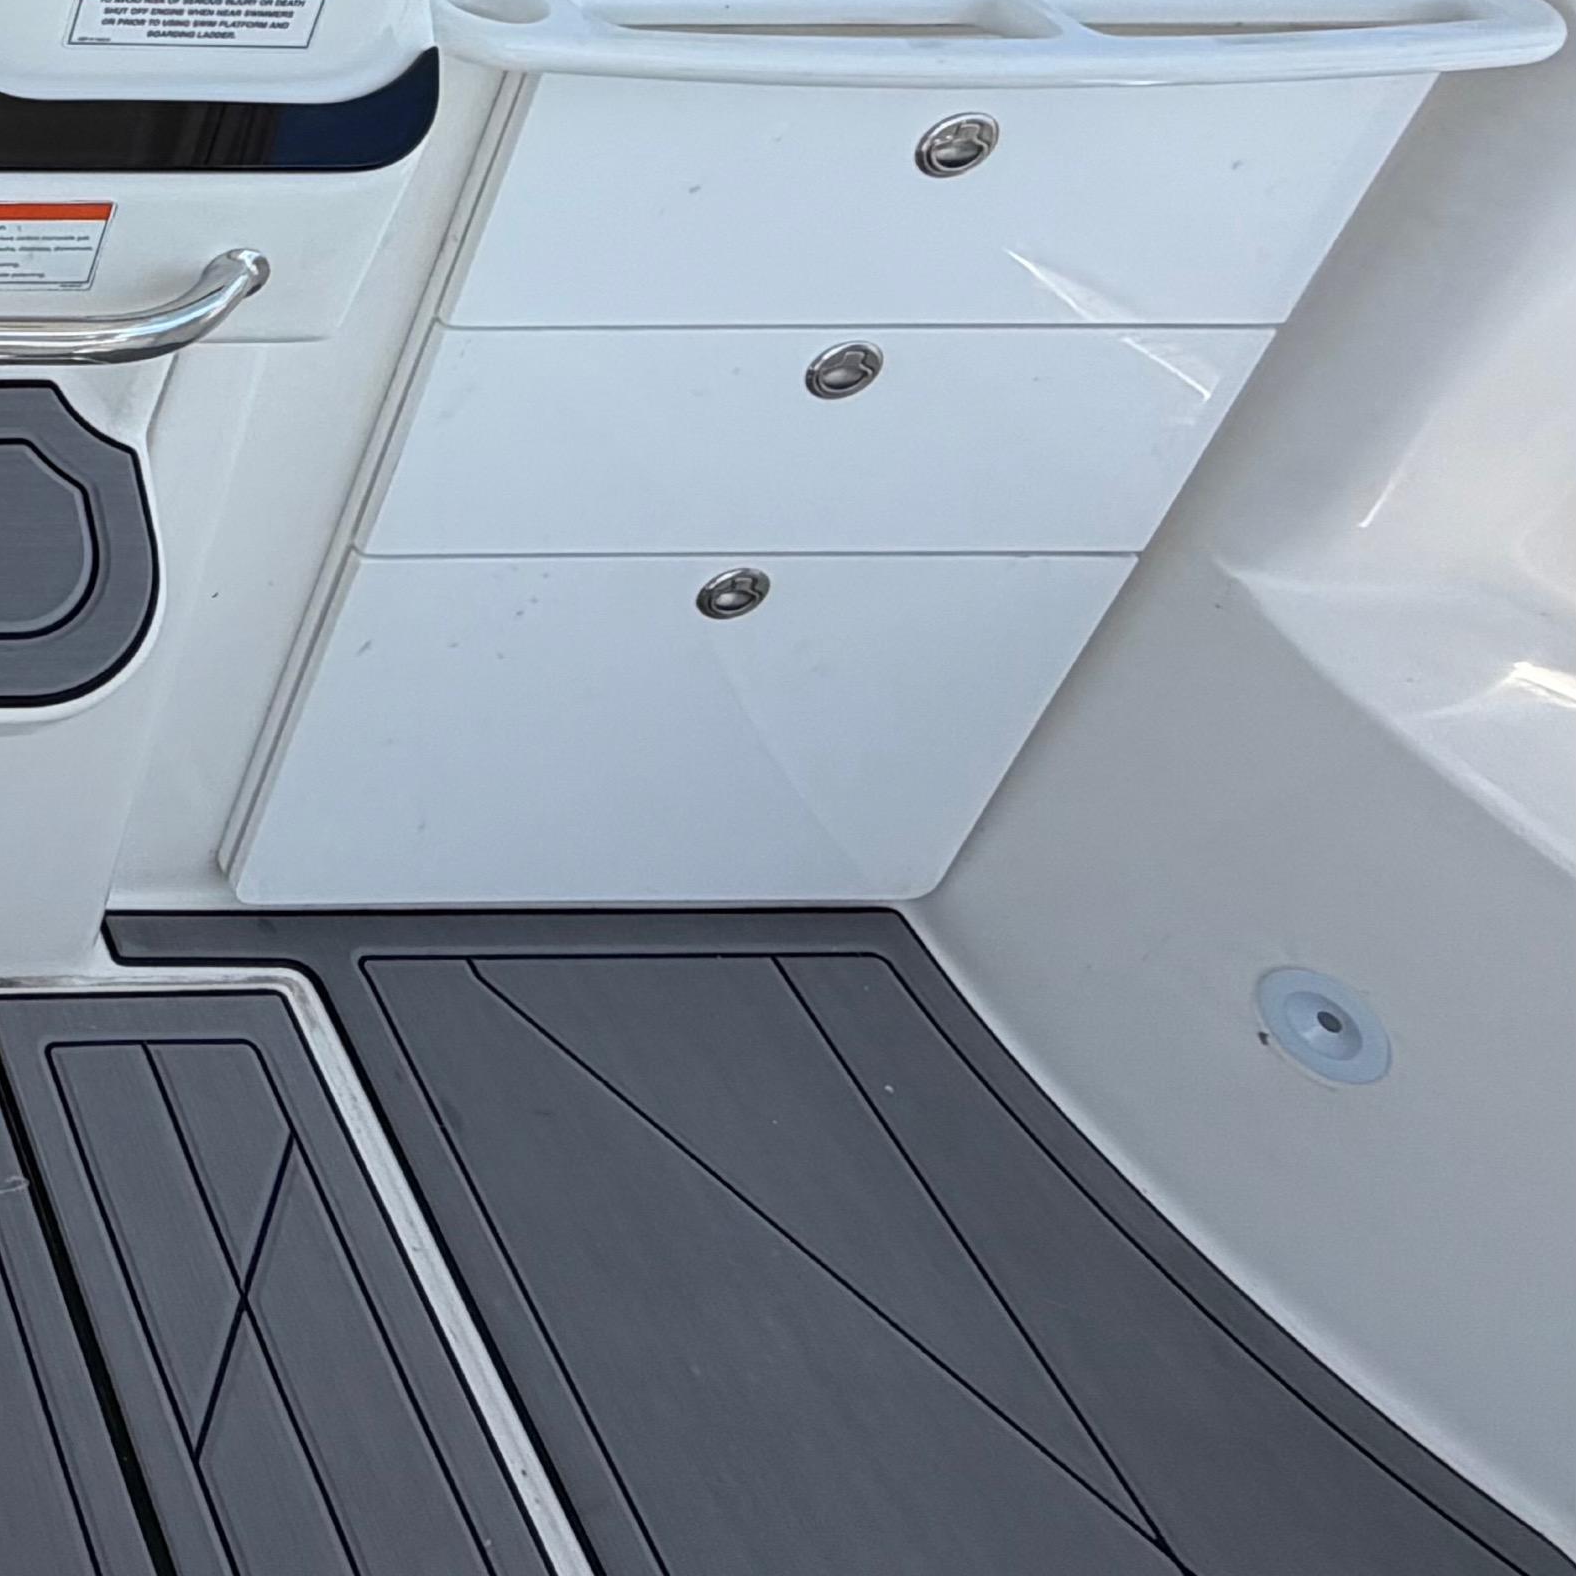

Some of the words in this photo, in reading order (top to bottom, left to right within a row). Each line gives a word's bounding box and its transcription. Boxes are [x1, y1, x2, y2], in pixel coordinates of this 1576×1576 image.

[275, 0, 306, 7] DEATH
[103, 7, 129, 15] SHUT
[150, 8, 185, 16] ENGINE
[216, 9, 242, 17] NEAR
[101, 18, 115, 26] OR
[117, 18, 146, 26] PRIOR
[218, 20, 268, 29] PLATFORM
[268, 22, 290, 30] AND
[146, 30, 196, 38] BOARDING
